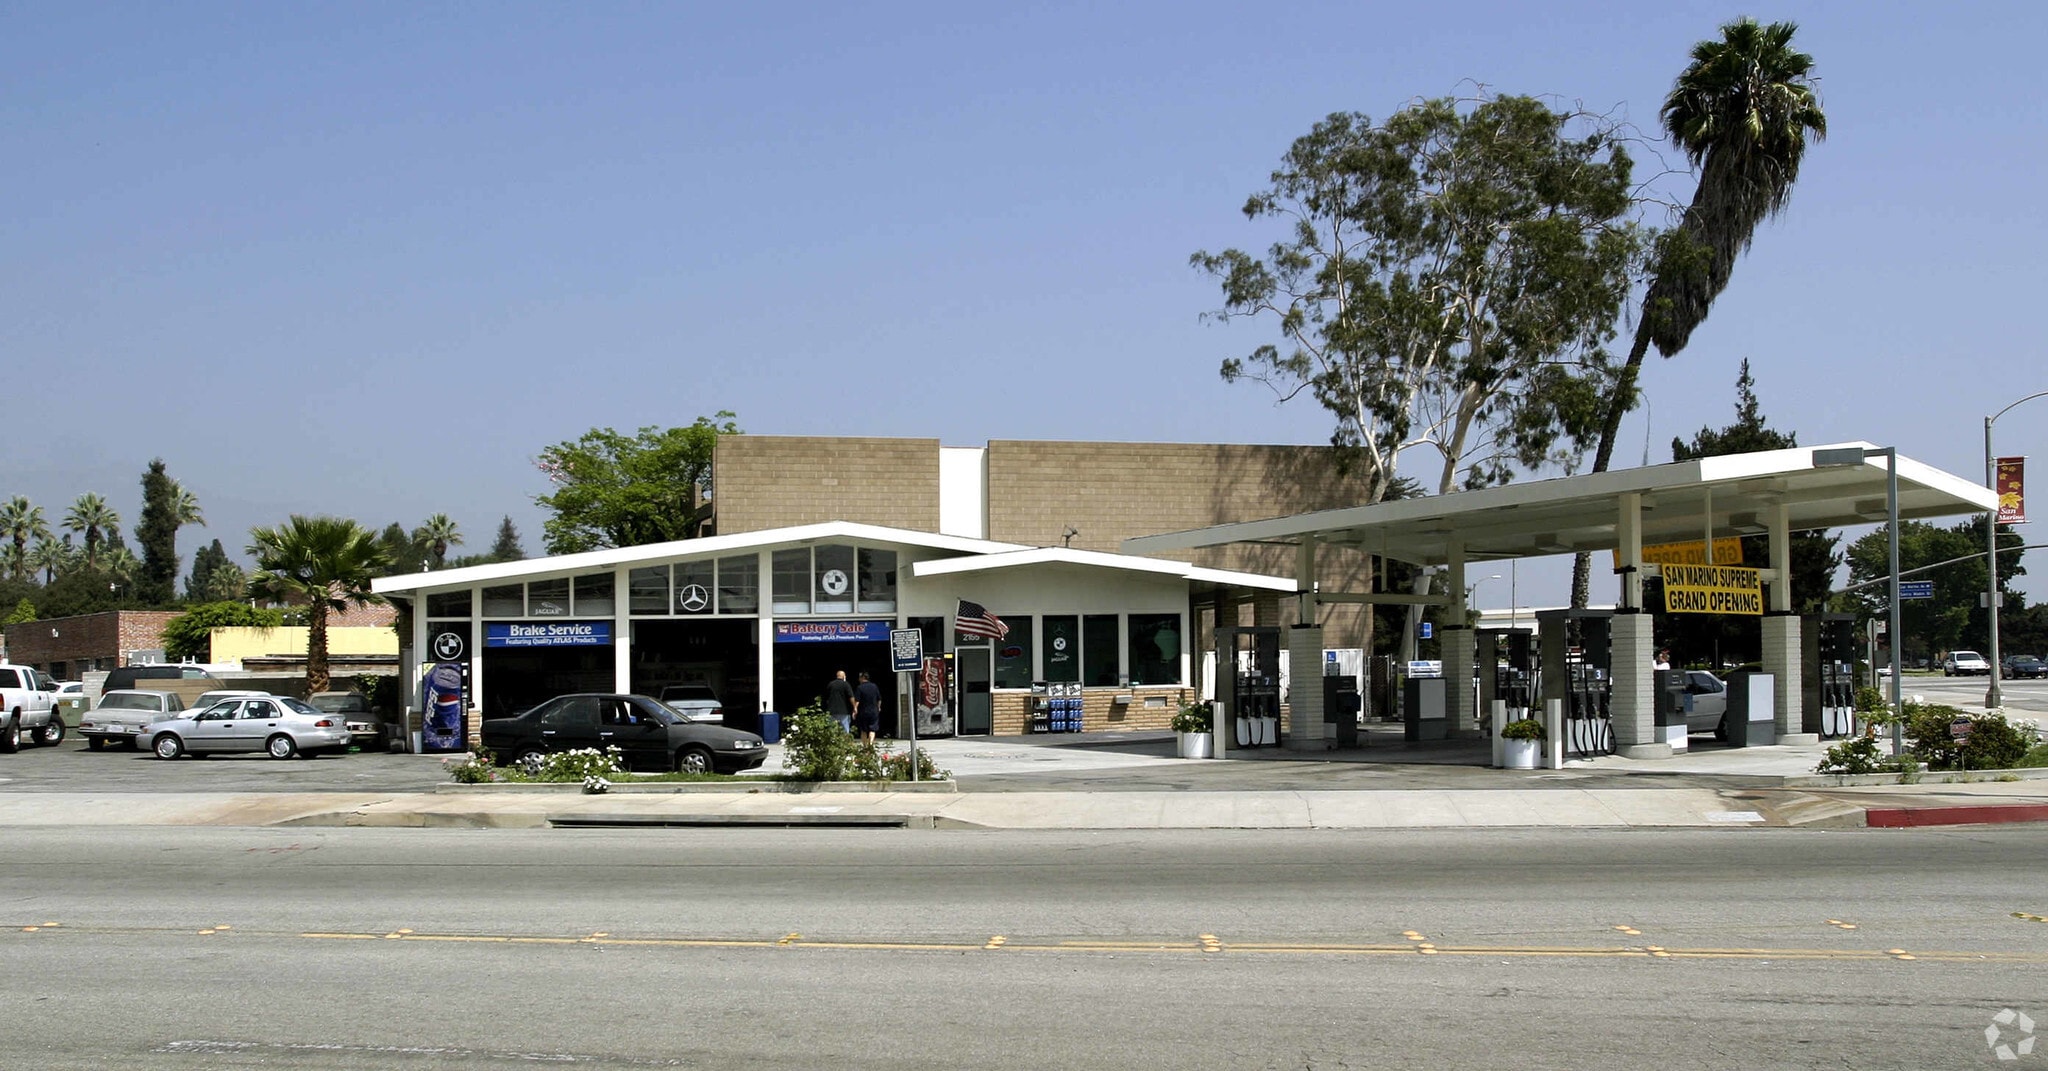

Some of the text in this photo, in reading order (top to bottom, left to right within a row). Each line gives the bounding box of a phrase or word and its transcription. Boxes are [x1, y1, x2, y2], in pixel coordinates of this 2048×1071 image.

[1665, 566, 1758, 589] SAN MARINO SUPREME
[1670, 591, 1759, 612] GRAND OPENING
[510, 624, 592, 636] Brake Service
[791, 623, 837, 635] Battery
[506, 638, 532, 646] Featuring
[1596, 670, 1601, 679] 3
[1265, 677, 1270, 685] 7
[425, 687, 439, 725] PEPSI
